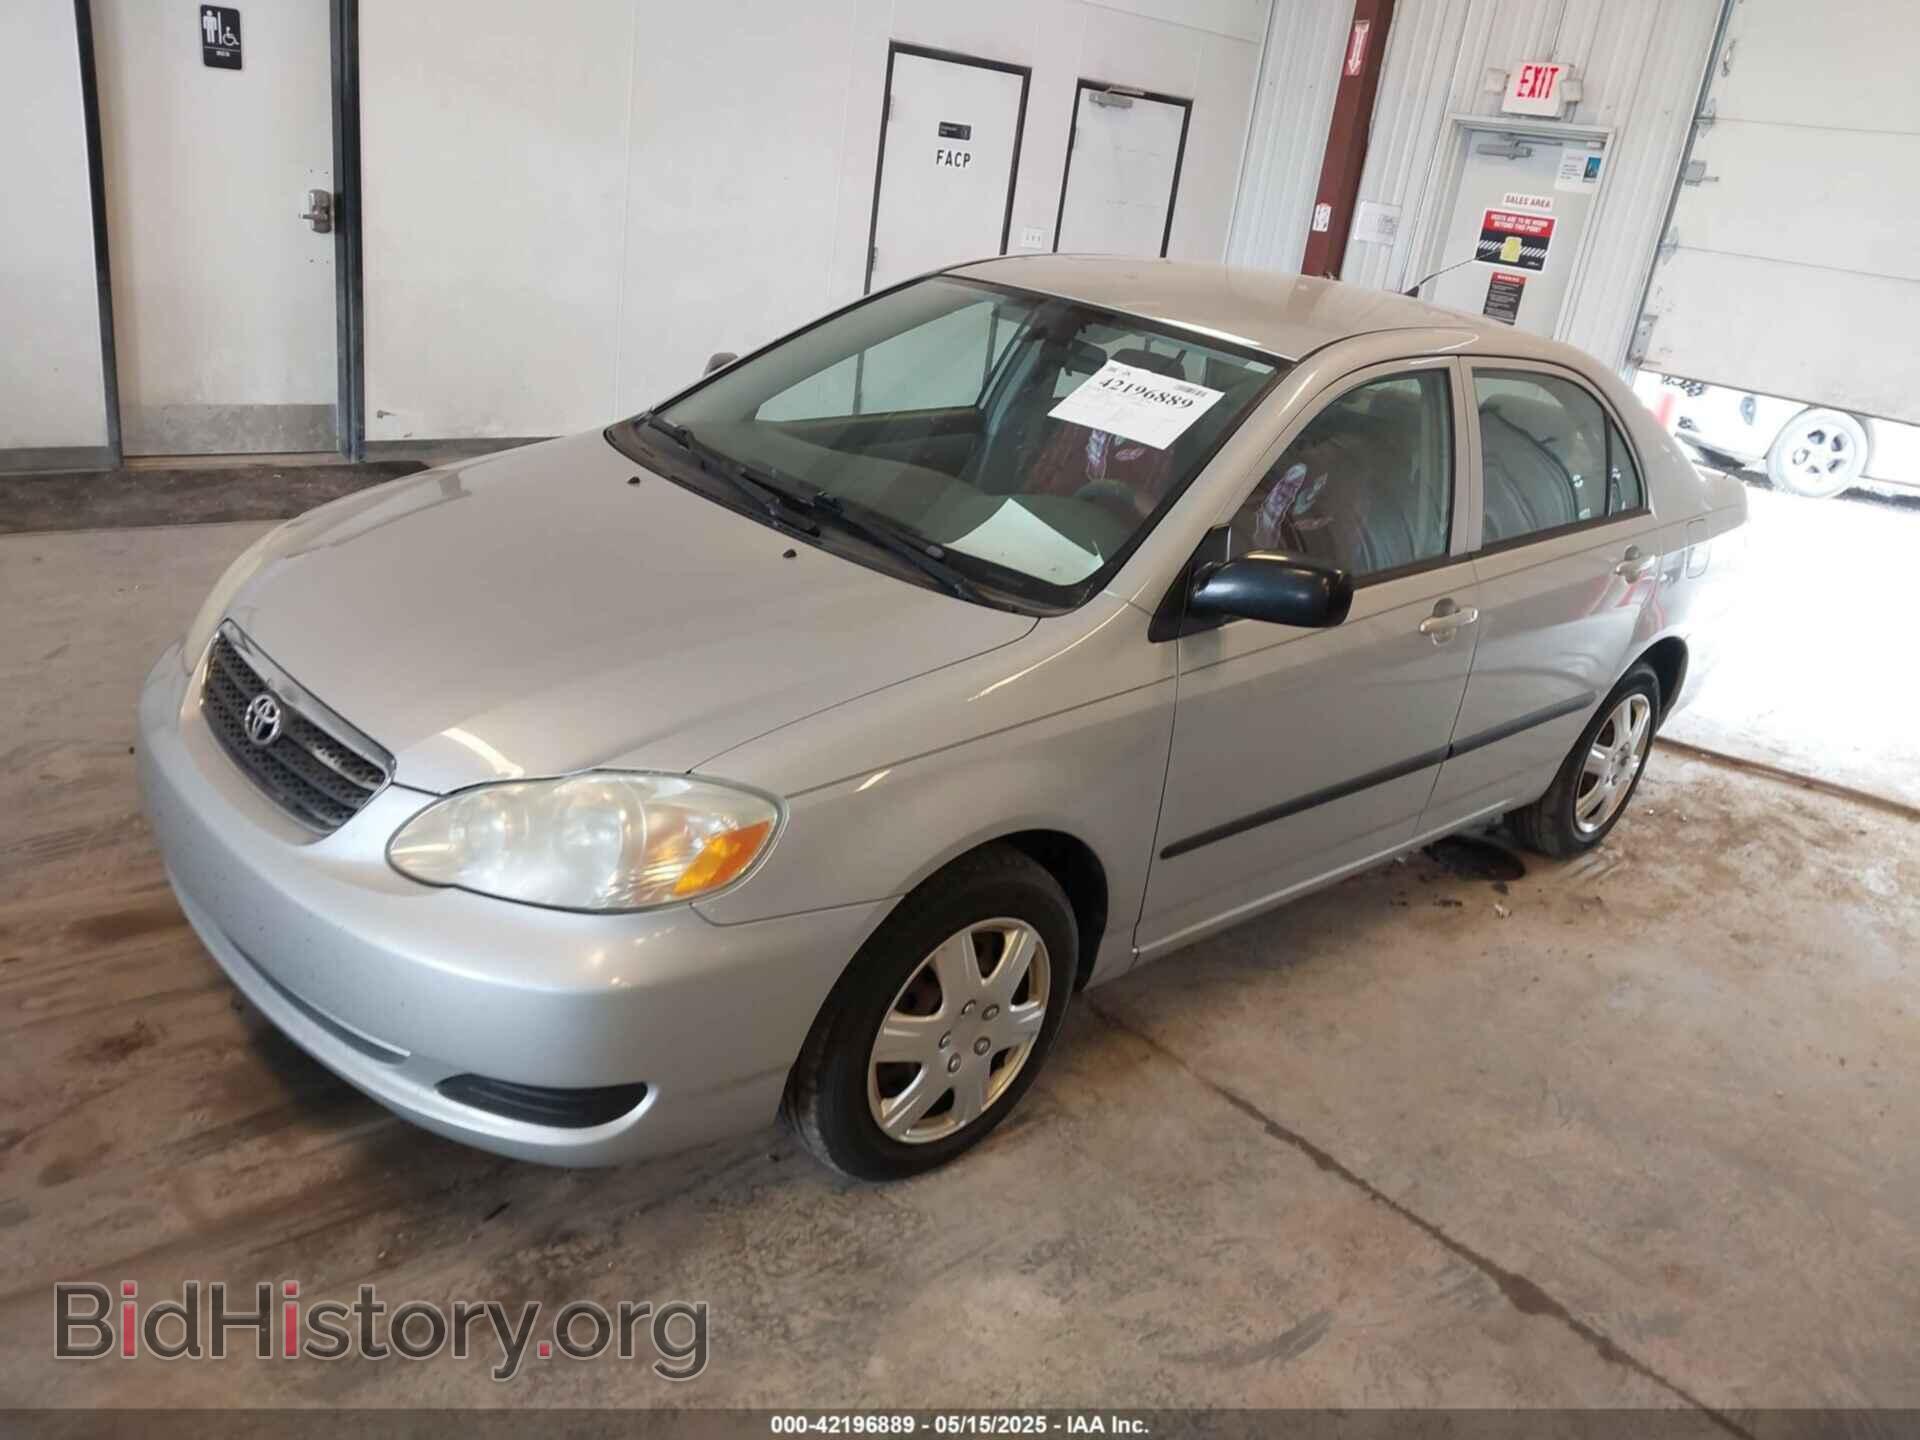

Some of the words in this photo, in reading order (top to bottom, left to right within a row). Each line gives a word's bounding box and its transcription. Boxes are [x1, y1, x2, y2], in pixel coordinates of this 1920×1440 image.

[1517, 65, 1559, 99] EXIT
[935, 149, 972, 169] FACP
[1530, 198, 1551, 208] AREA
[1099, 377, 1194, 408] 42196889
